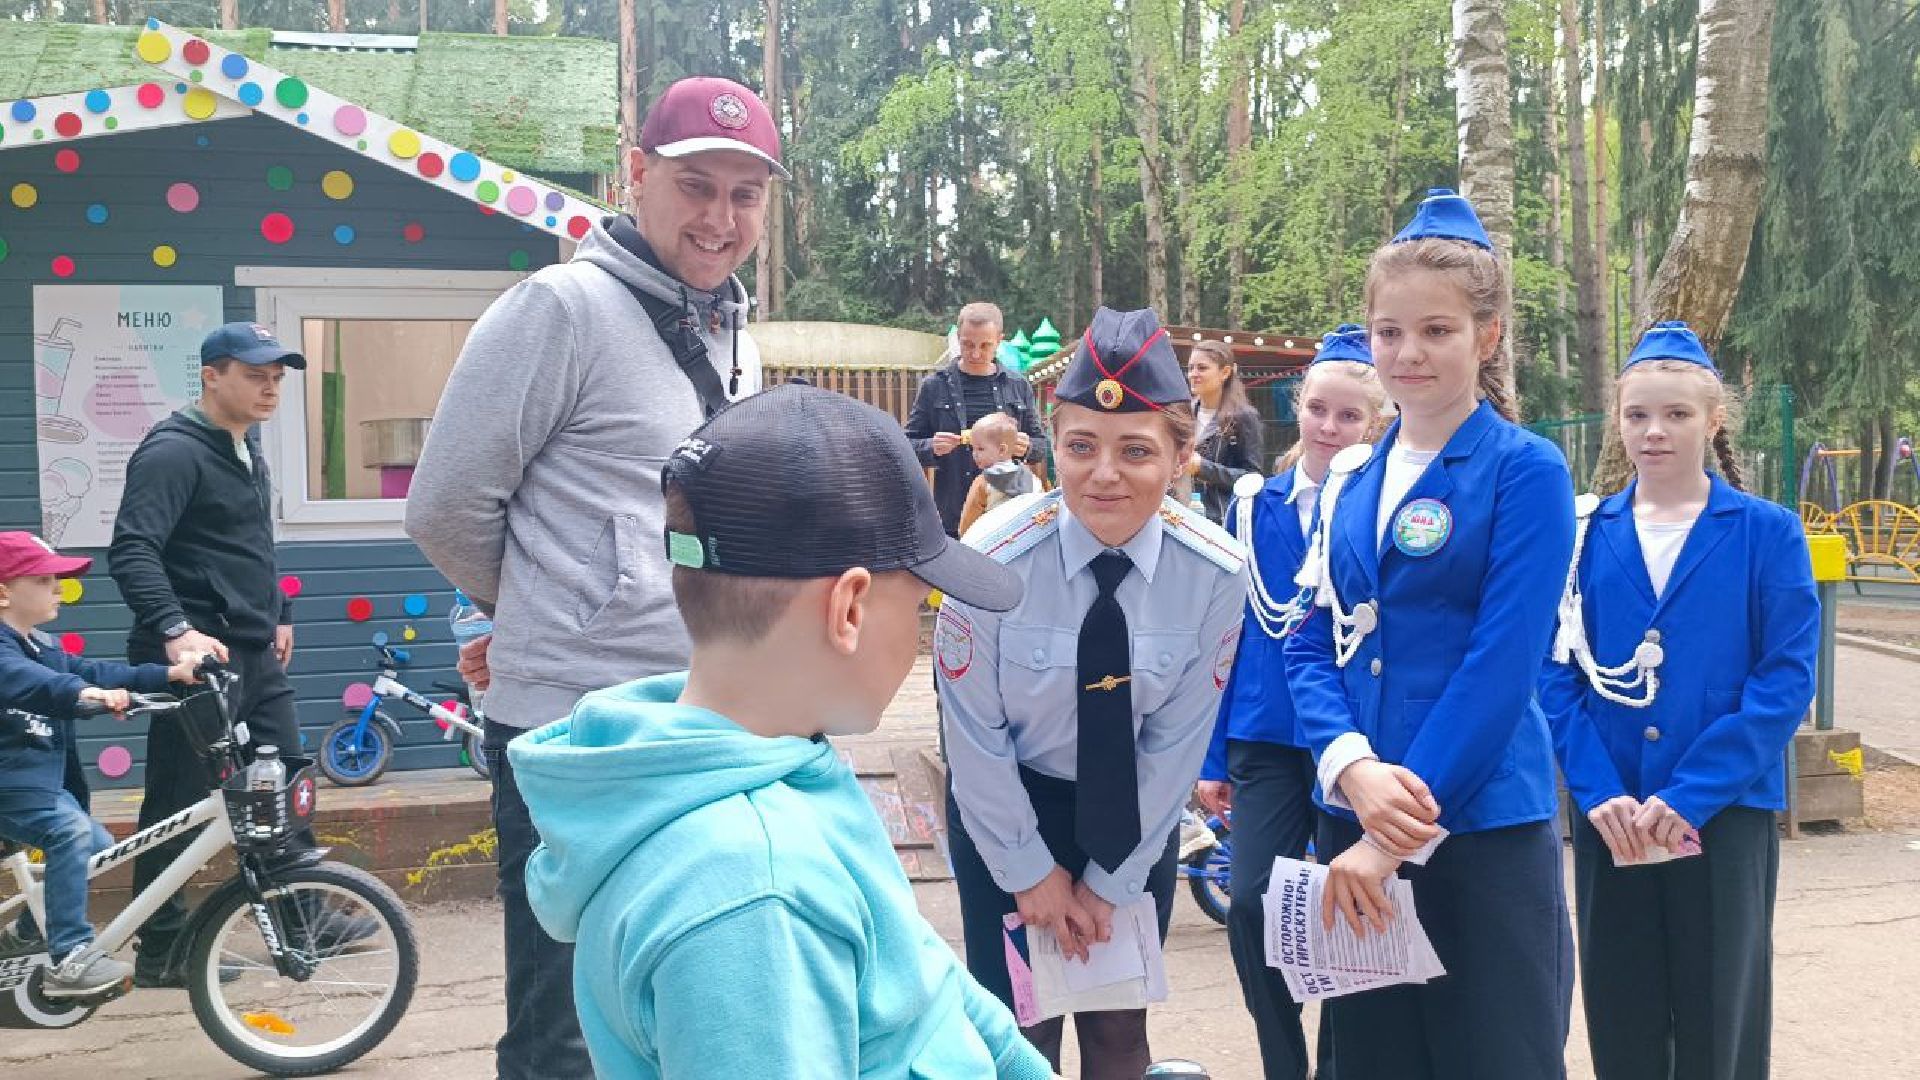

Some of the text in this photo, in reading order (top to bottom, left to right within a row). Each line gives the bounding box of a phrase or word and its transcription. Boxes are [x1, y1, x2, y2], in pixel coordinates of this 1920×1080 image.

[117, 312, 171, 328] МЕНЮ
[1281, 879, 1295, 965] ОСТОРОЖНО!
[1295, 868, 1311, 968] ГИРОСКУТЕРЫ!
